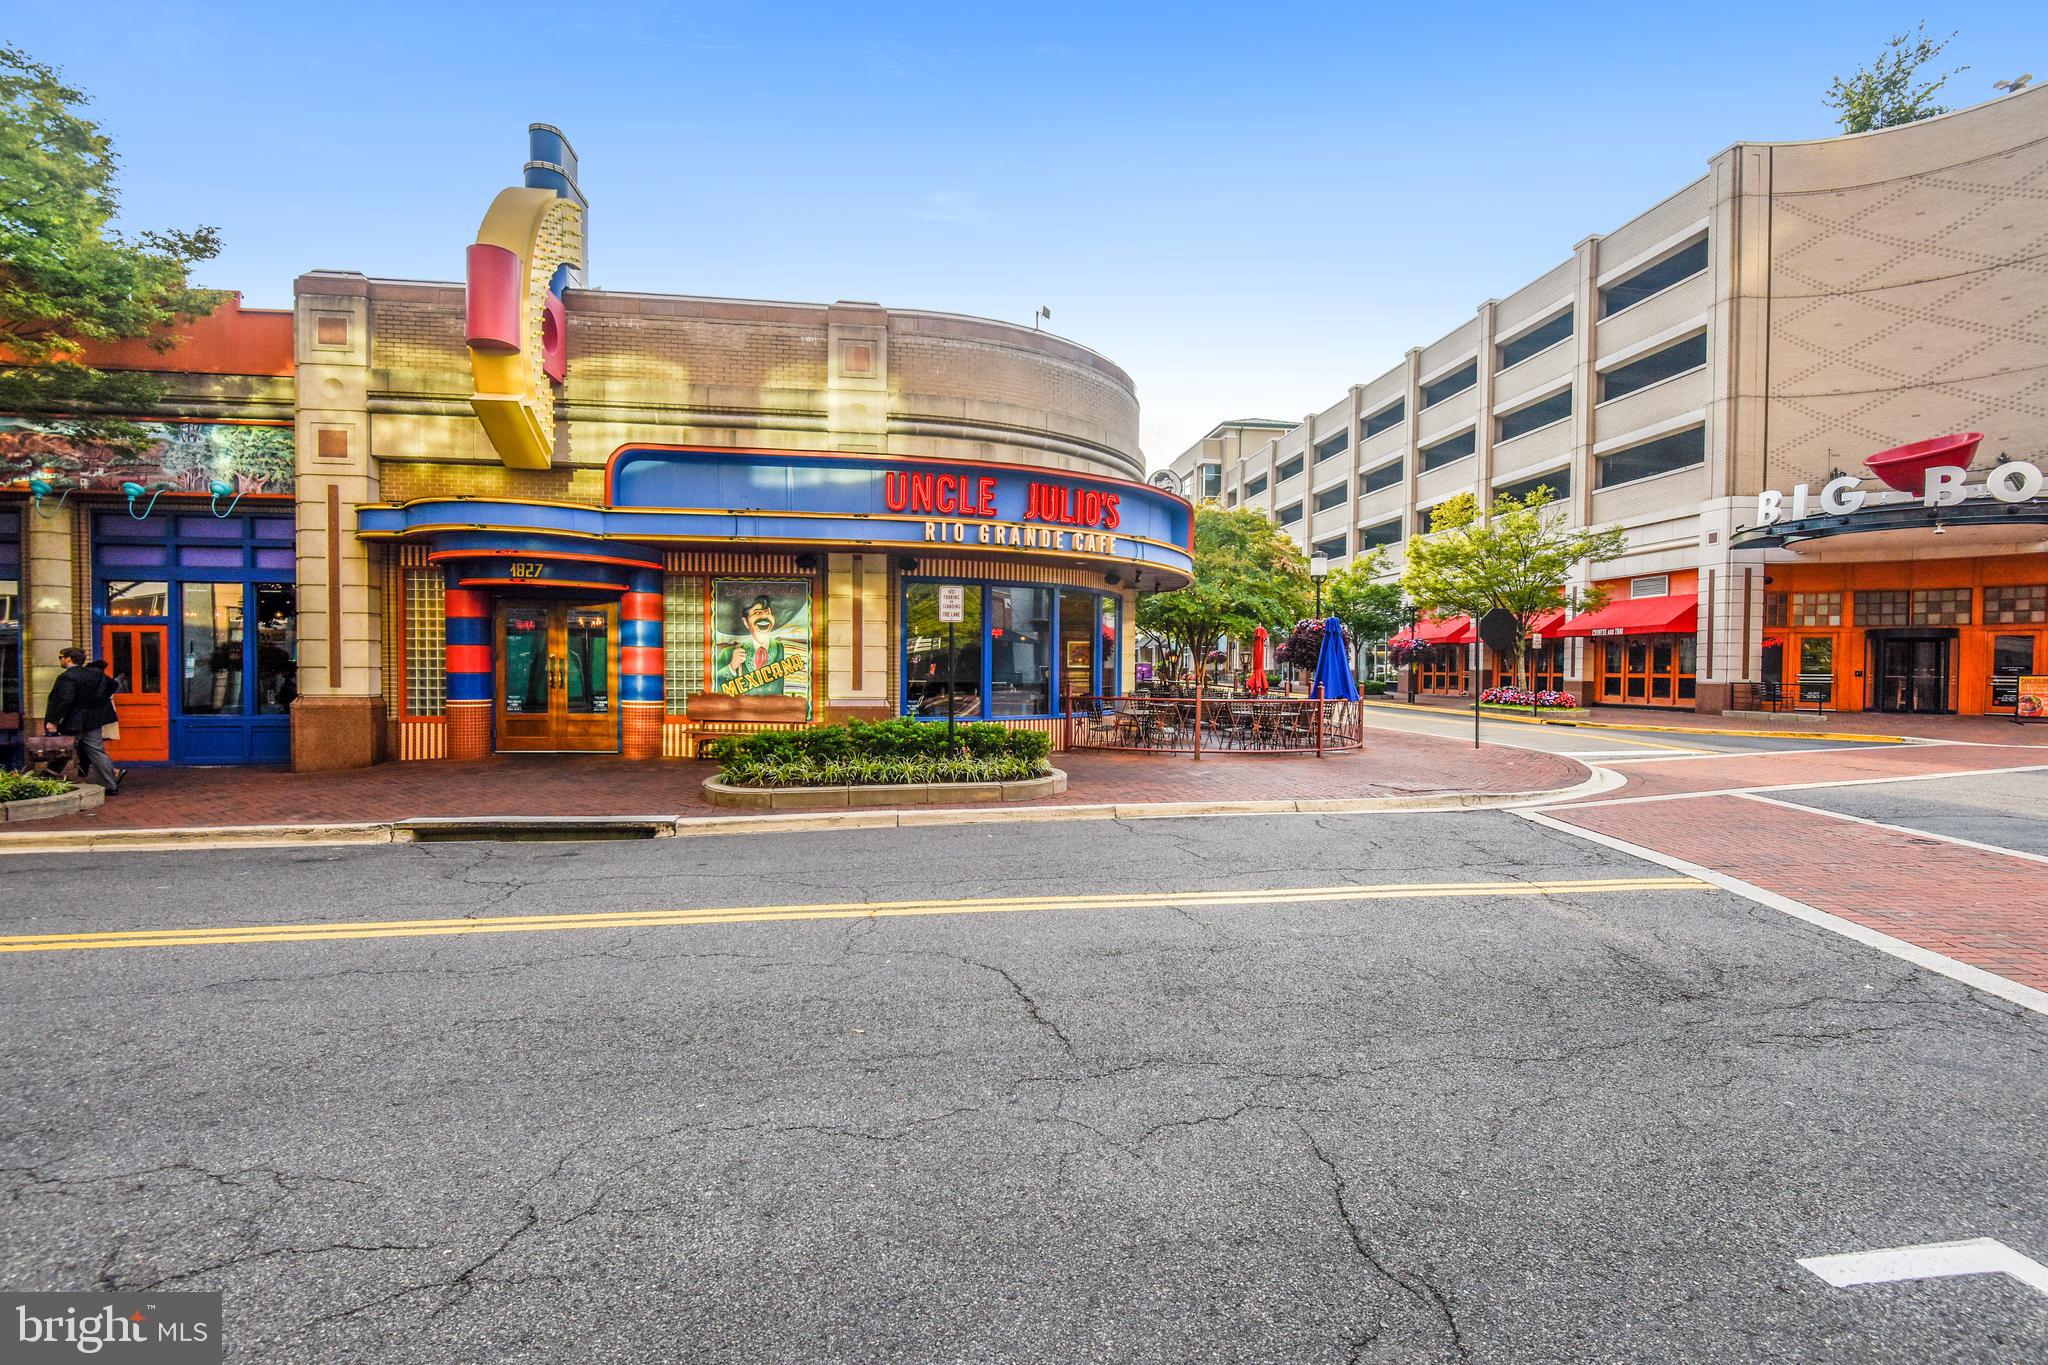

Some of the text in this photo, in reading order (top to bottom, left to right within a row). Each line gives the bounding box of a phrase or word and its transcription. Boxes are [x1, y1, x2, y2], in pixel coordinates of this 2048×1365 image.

[886, 471, 1121, 529] UNCLE JULIO'S
[1756, 461, 2043, 527] BIG BO
[925, 522, 1116, 554] RIO GRANDE CAFE
[510, 563, 544, 578] 1827
[722, 654, 805, 697] MEXICANA
